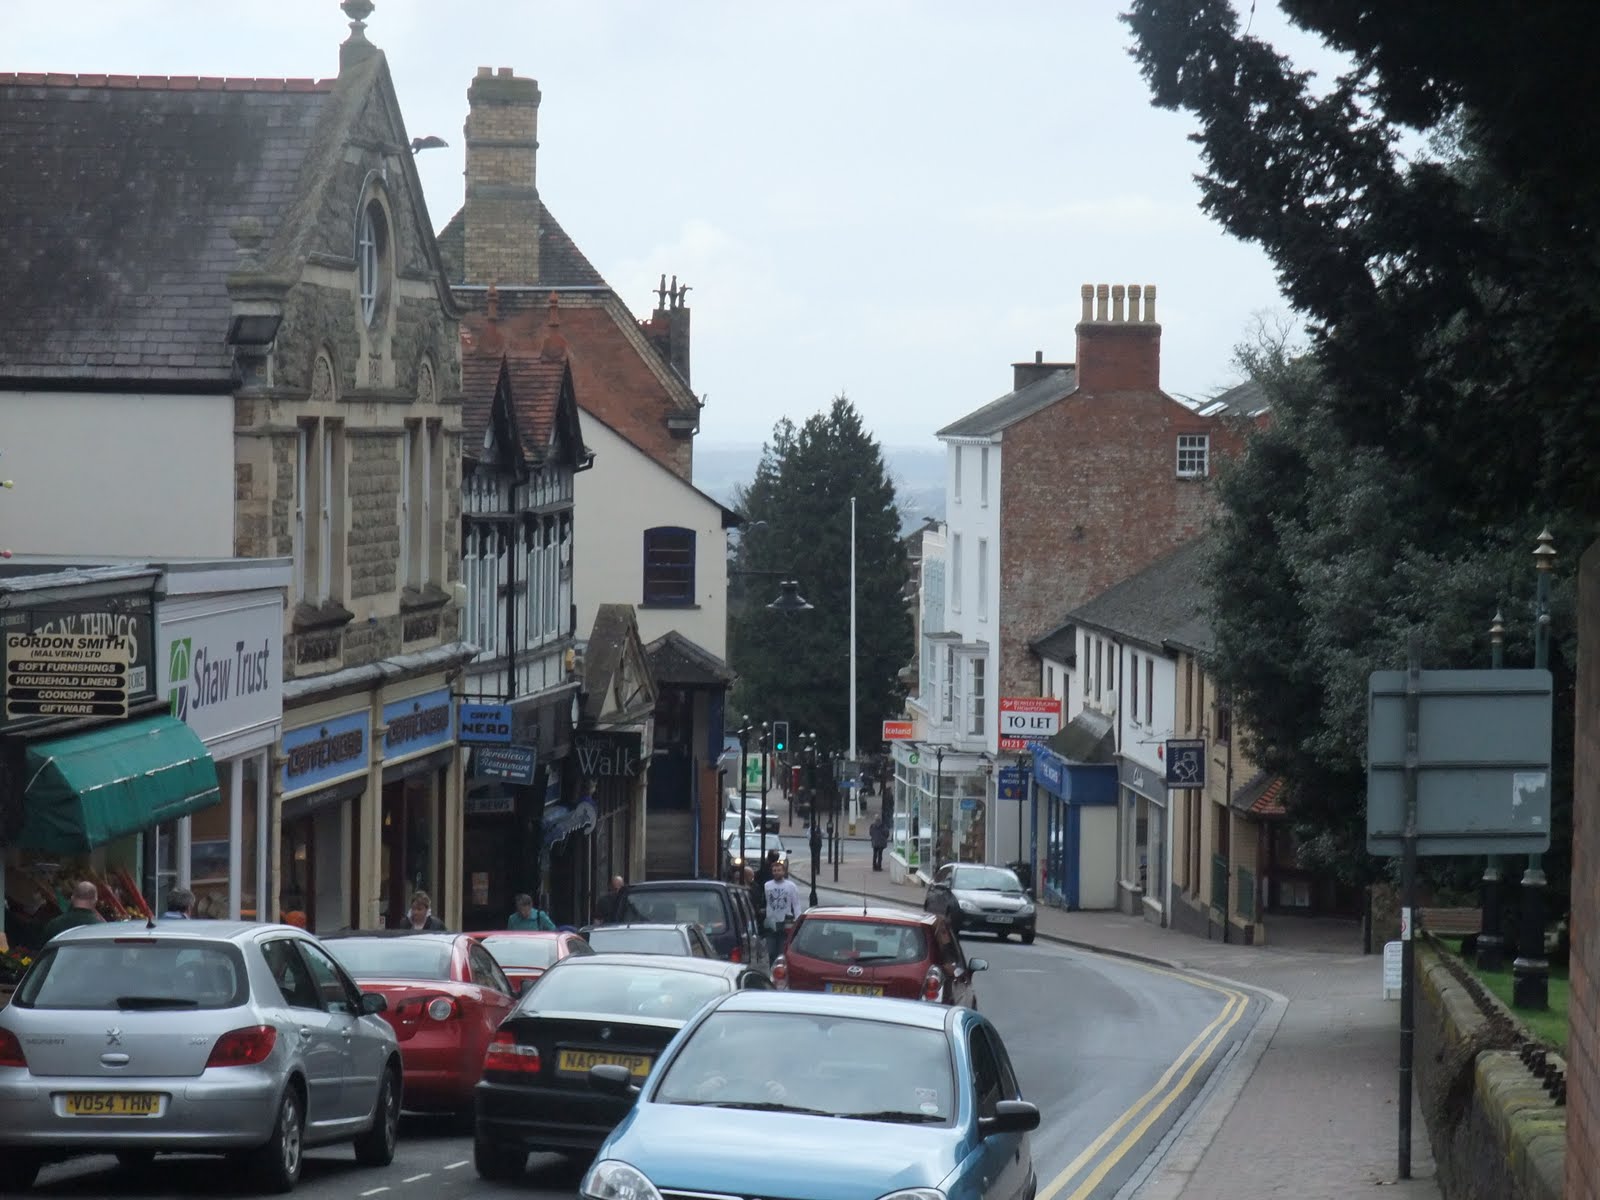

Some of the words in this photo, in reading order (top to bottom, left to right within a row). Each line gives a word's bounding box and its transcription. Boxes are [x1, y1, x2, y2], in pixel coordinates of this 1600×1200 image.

[8, 637, 76, 649] GORDON
[77, 638, 126, 650] SMITH
[18, 663, 46, 671] SOFT
[47, 663, 116, 672] FURNISHINGS
[192, 646, 232, 710] Shaw
[236, 638, 270, 697] Trust
[16, 677, 79, 686] HOUSEHOLD
[81, 678, 117, 687] LINENS
[38, 690, 95, 699] COOKSHOP
[40, 704, 93, 713] GIFTWARE
[1007, 716, 1026, 728] TO
[1031, 717, 1052, 729] LET
[462, 723, 510, 735] NERO
[885, 727, 912, 736] Iceland
[1001, 740, 1020, 748] 0121
[480, 758, 530, 771] Restaurant
[576, 746, 635, 776] Walk
[73, 1095, 114, 1111] VO54
[121, 1095, 152, 1111] THN
